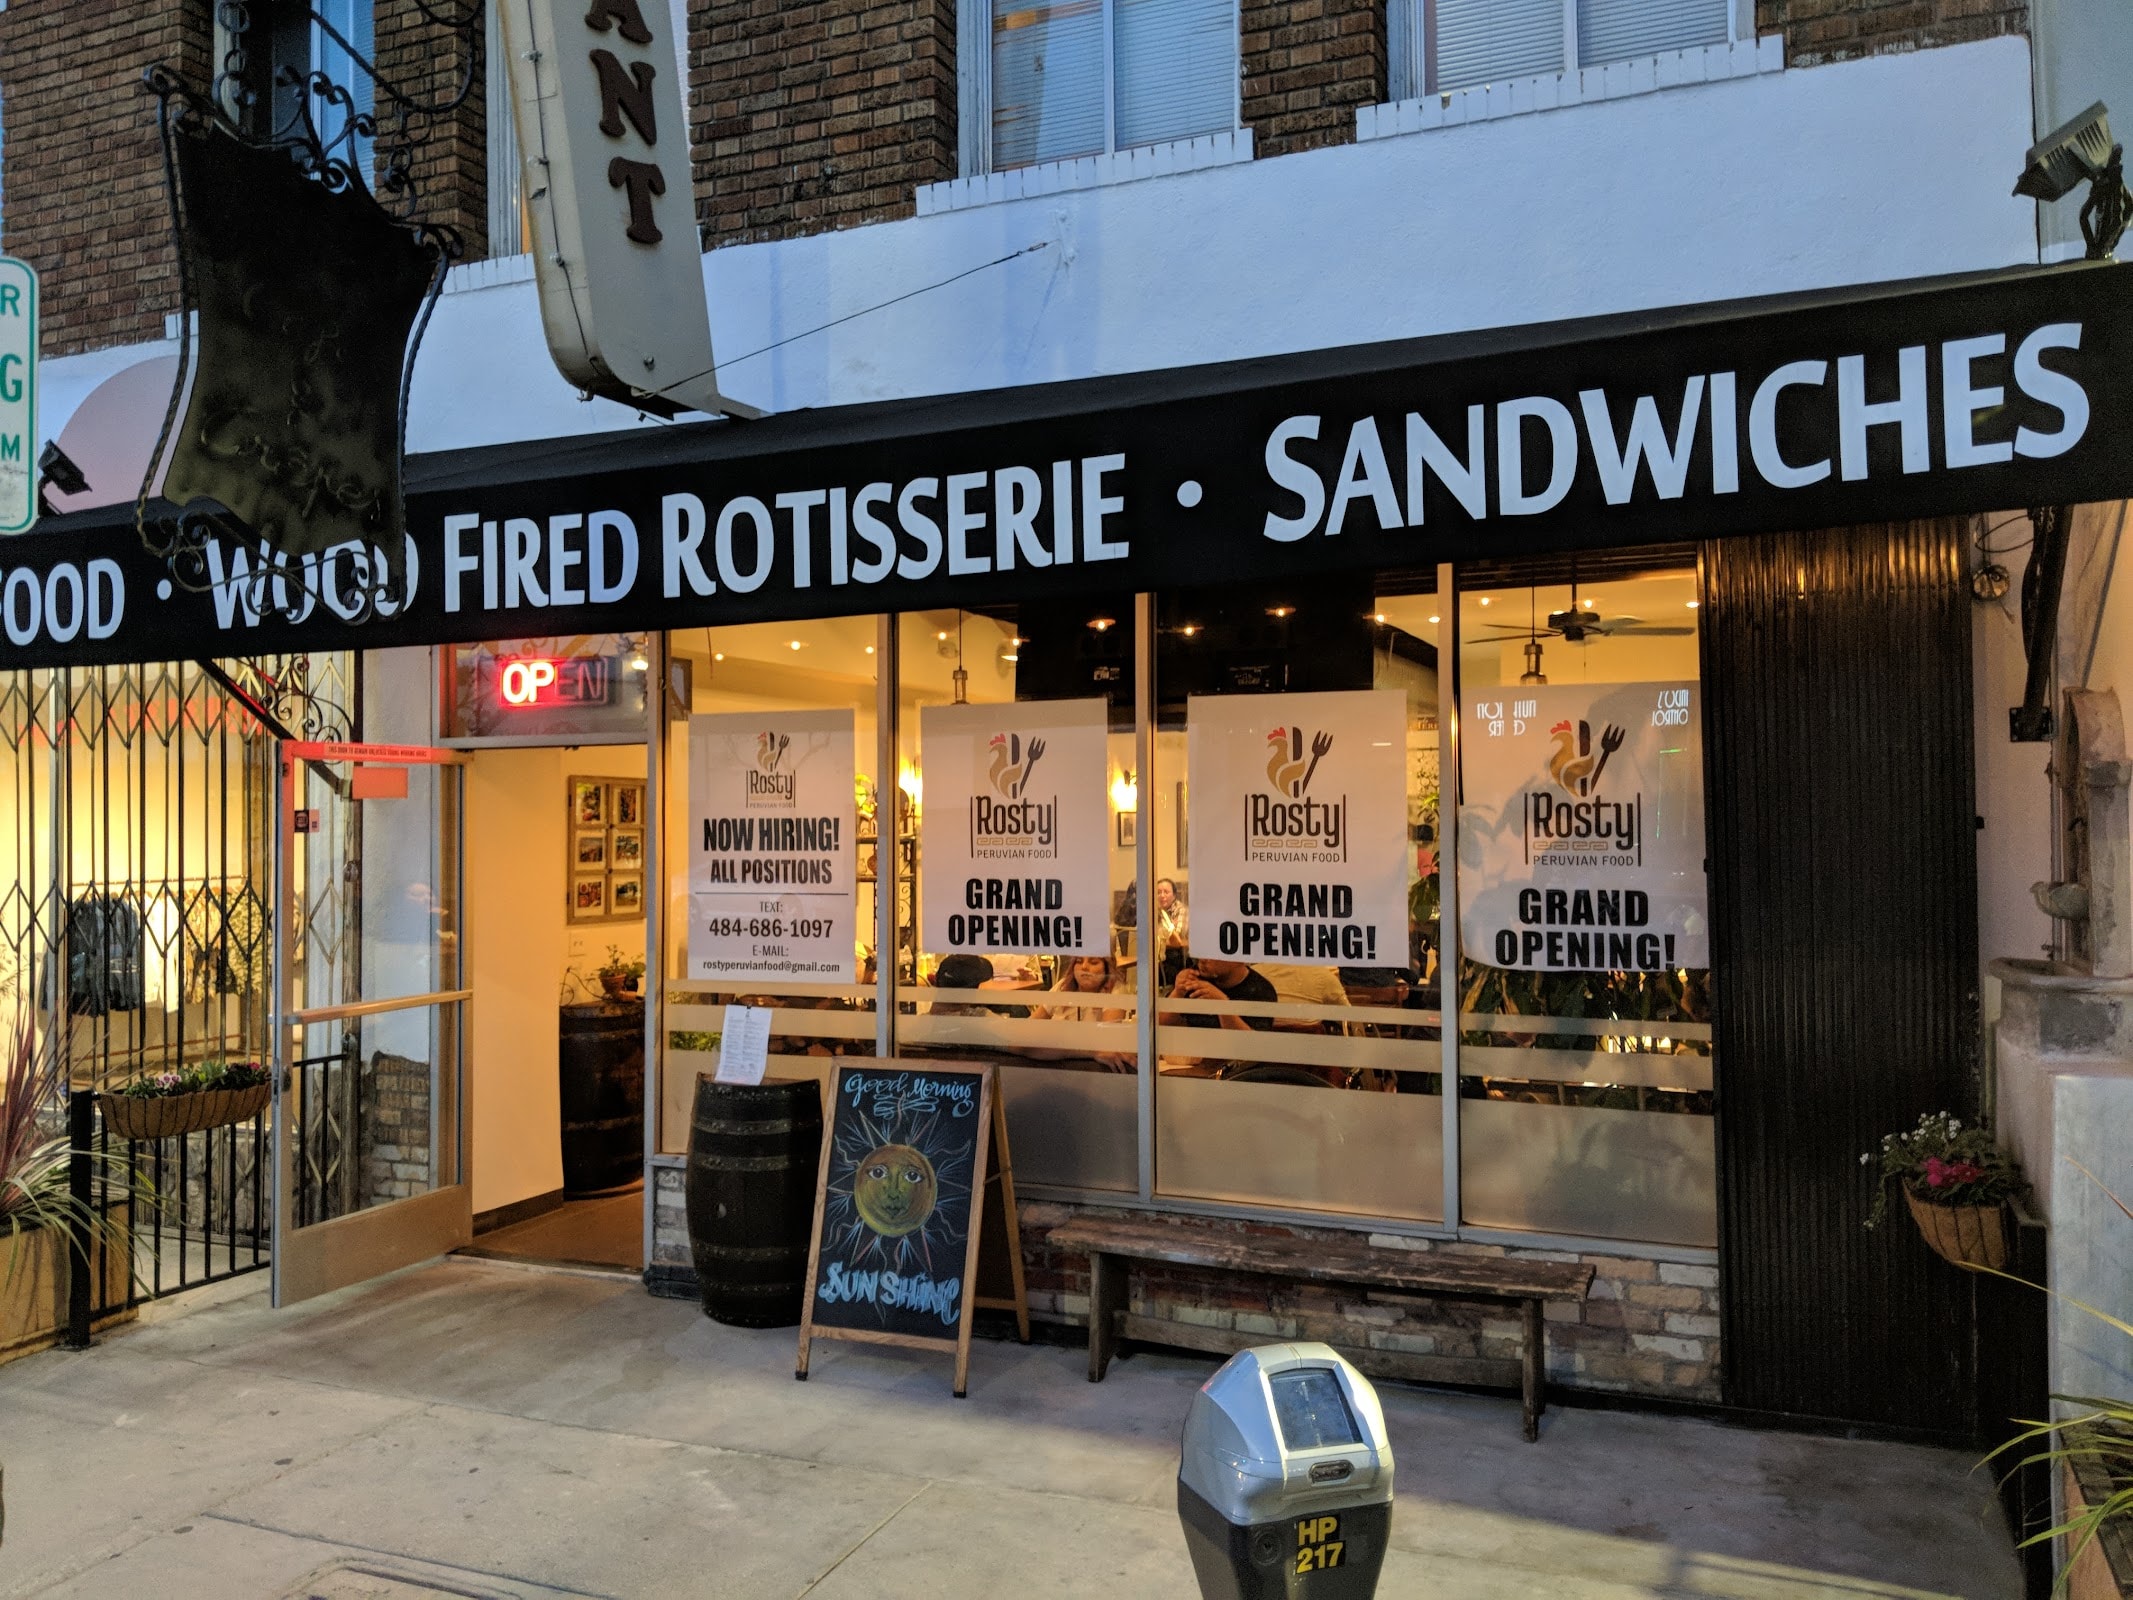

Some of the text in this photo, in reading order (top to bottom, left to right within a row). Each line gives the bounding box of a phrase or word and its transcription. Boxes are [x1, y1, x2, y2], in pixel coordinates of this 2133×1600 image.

[0, 557, 125, 647] OOD
[444, 510, 640, 613] FIRED
[661, 453, 1130, 599] ROTISSERIE
[1263, 322, 2090, 543] SANDWICHES
[502, 662, 601, 704] OPEN
[750, 770, 793, 800] Rosty
[703, 817, 840, 851] NOW HIRING!
[976, 795, 1052, 845] Rosty
[1251, 793, 1340, 848] Rosty
[1532, 792, 1634, 850] Rosty
[977, 849, 1052, 859] PERUVIAN FOOD
[1252, 852, 1340, 863] PERUVIAN FOOD
[1533, 855, 1634, 866] PERUVIAN FOOD
[711, 859, 832, 884] ALL POSITIONS
[760, 901, 783, 913] TEXT:
[966, 878, 1063, 910] GRAND
[1239, 882, 1353, 918] GRAND
[1519, 888, 1648, 927] GRAND
[709, 918, 834, 938] 484-686-1097
[948, 914, 1083, 948] OPENING!
[1219, 921, 1376, 960] OPENING!
[752, 945, 789, 957] E-MAIL:
[1495, 929, 1676, 970] OPENING!
[703, 960, 840, 973] rostyperuvianfood@gmail.com
[844, 1072, 909, 1108] Good
[1298, 1516, 1338, 1546] HP
[1296, 1542, 1344, 1574] 217
